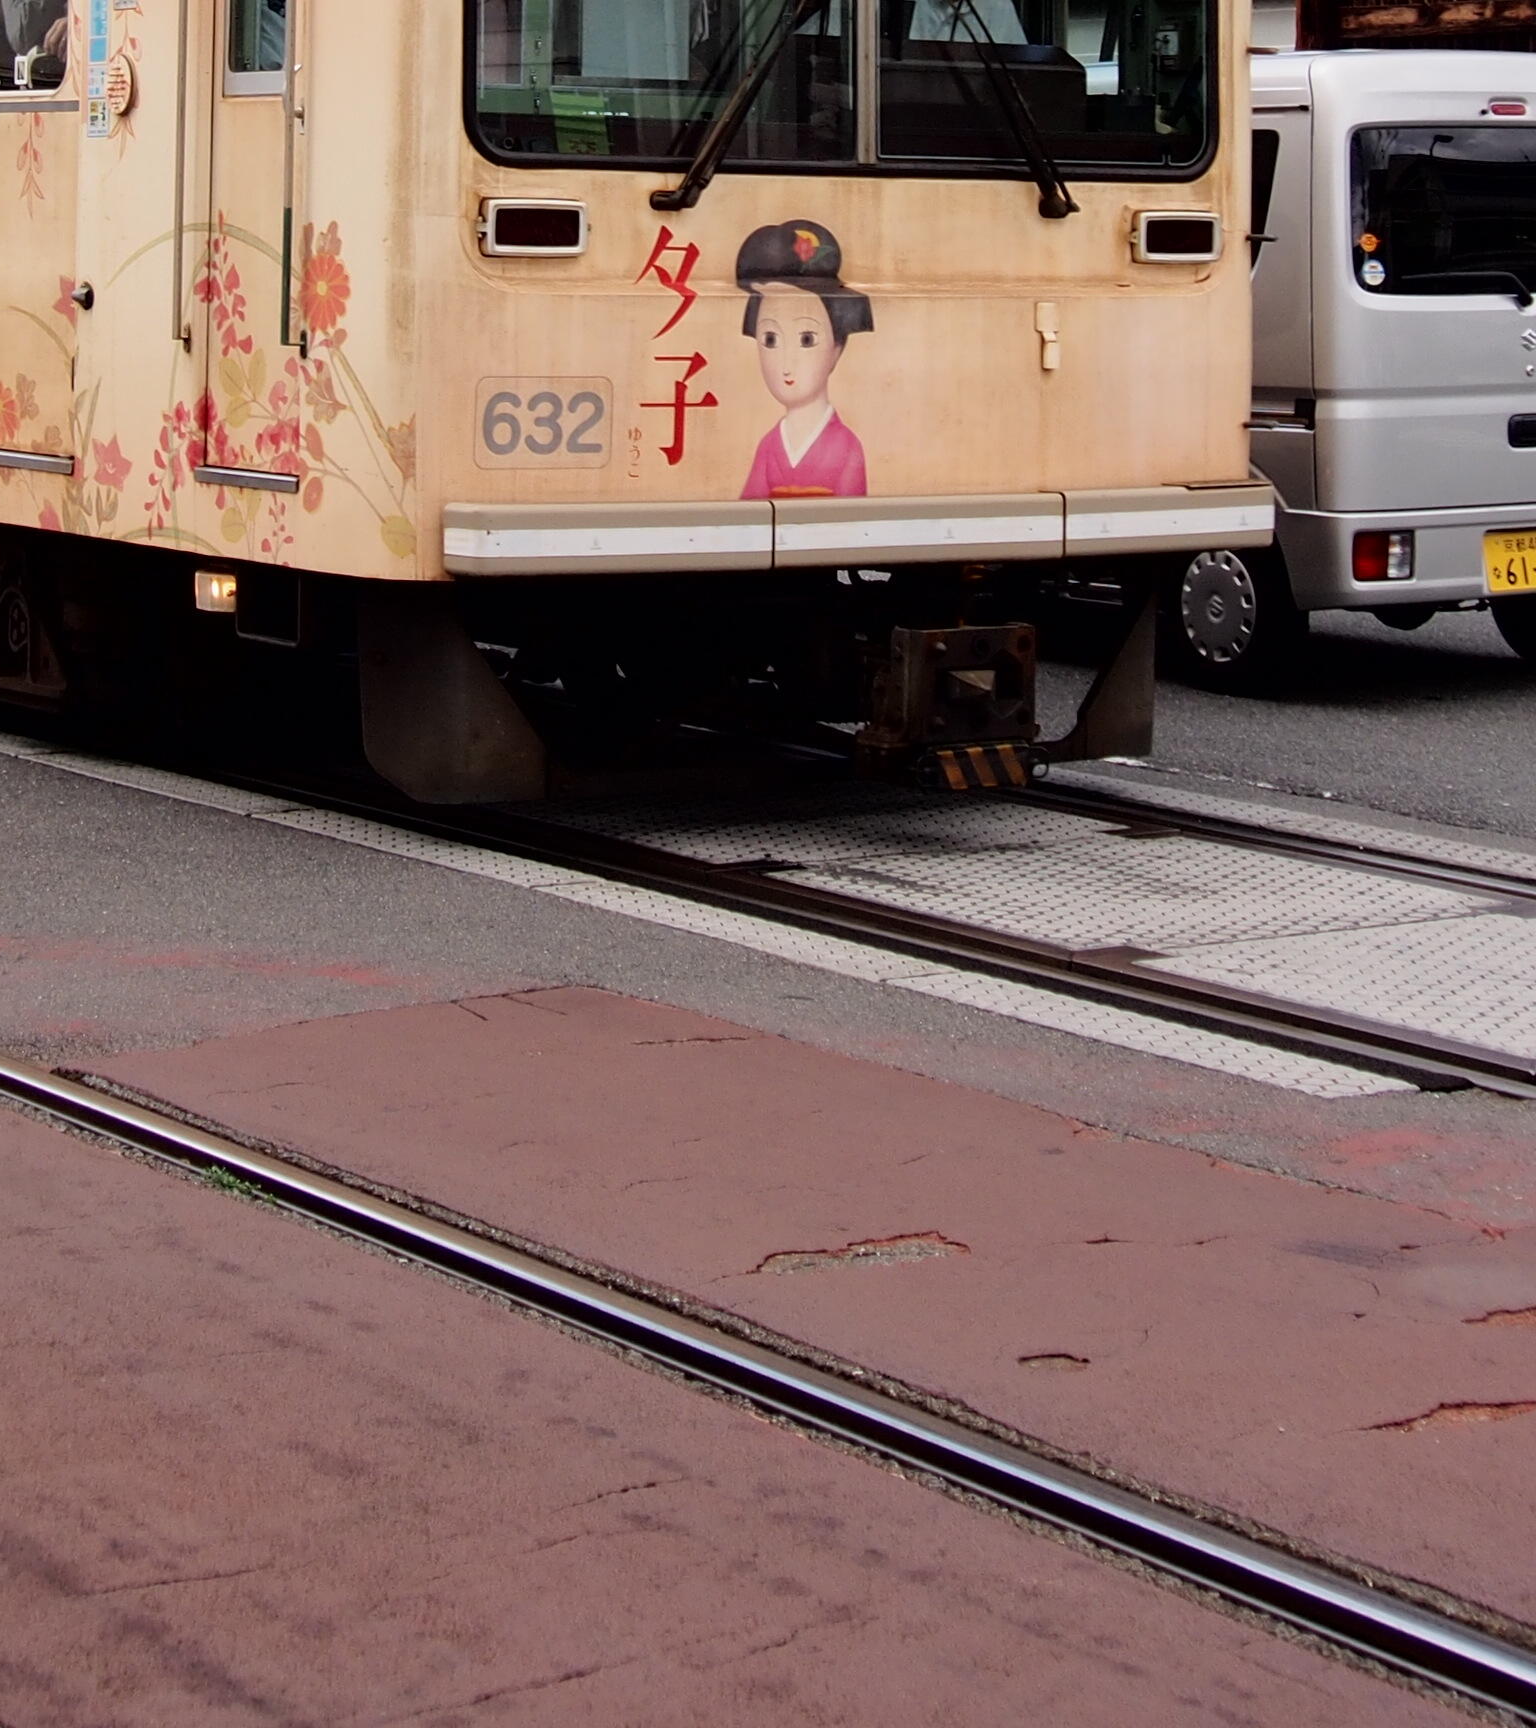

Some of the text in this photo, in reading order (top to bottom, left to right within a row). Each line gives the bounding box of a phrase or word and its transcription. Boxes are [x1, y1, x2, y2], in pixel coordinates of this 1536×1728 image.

[635, 225, 718, 466] 夕子
[482, 391, 605, 455] 632
[627, 426, 643, 479] ゆうこ
